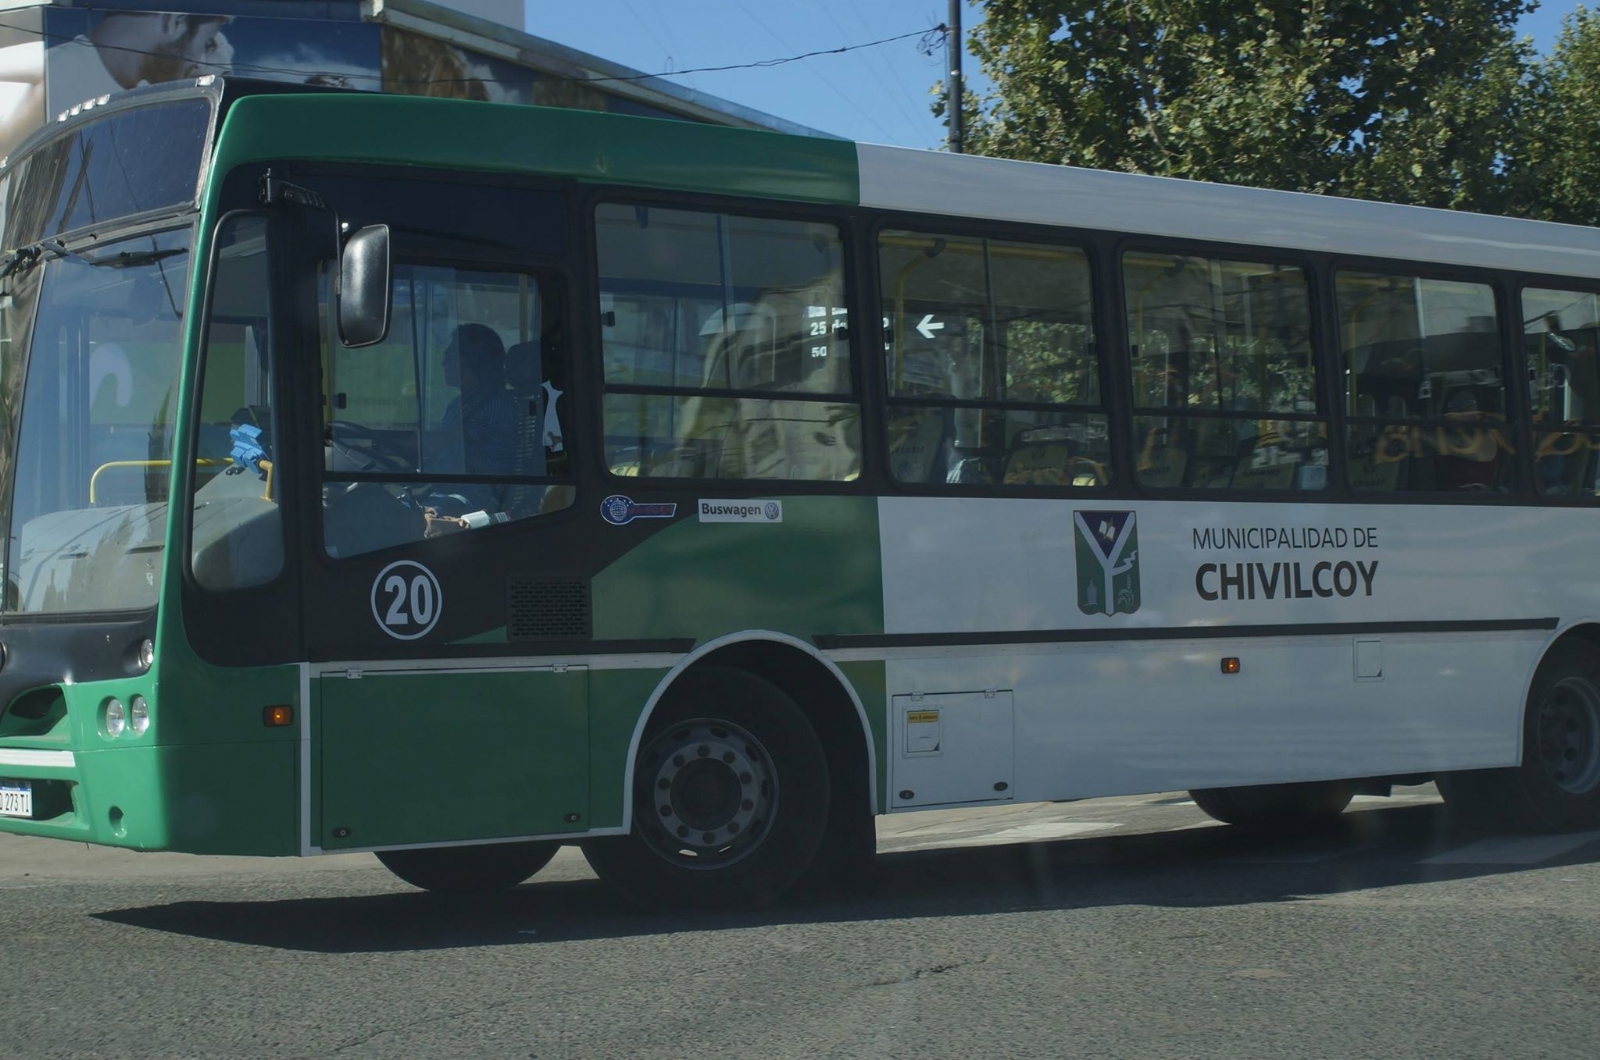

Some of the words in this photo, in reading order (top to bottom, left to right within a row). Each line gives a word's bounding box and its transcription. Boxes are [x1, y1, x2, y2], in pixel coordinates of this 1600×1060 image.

[810, 321, 827, 336] 25
[811, 346, 827, 358] 50
[702, 503, 762, 518] Buswagen
[1193, 527, 1348, 550] MUNICIPALIDAD
[1354, 527, 1378, 548] DE
[1195, 560, 1379, 601] CHIVILCOY
[384, 575, 433, 625] 20
